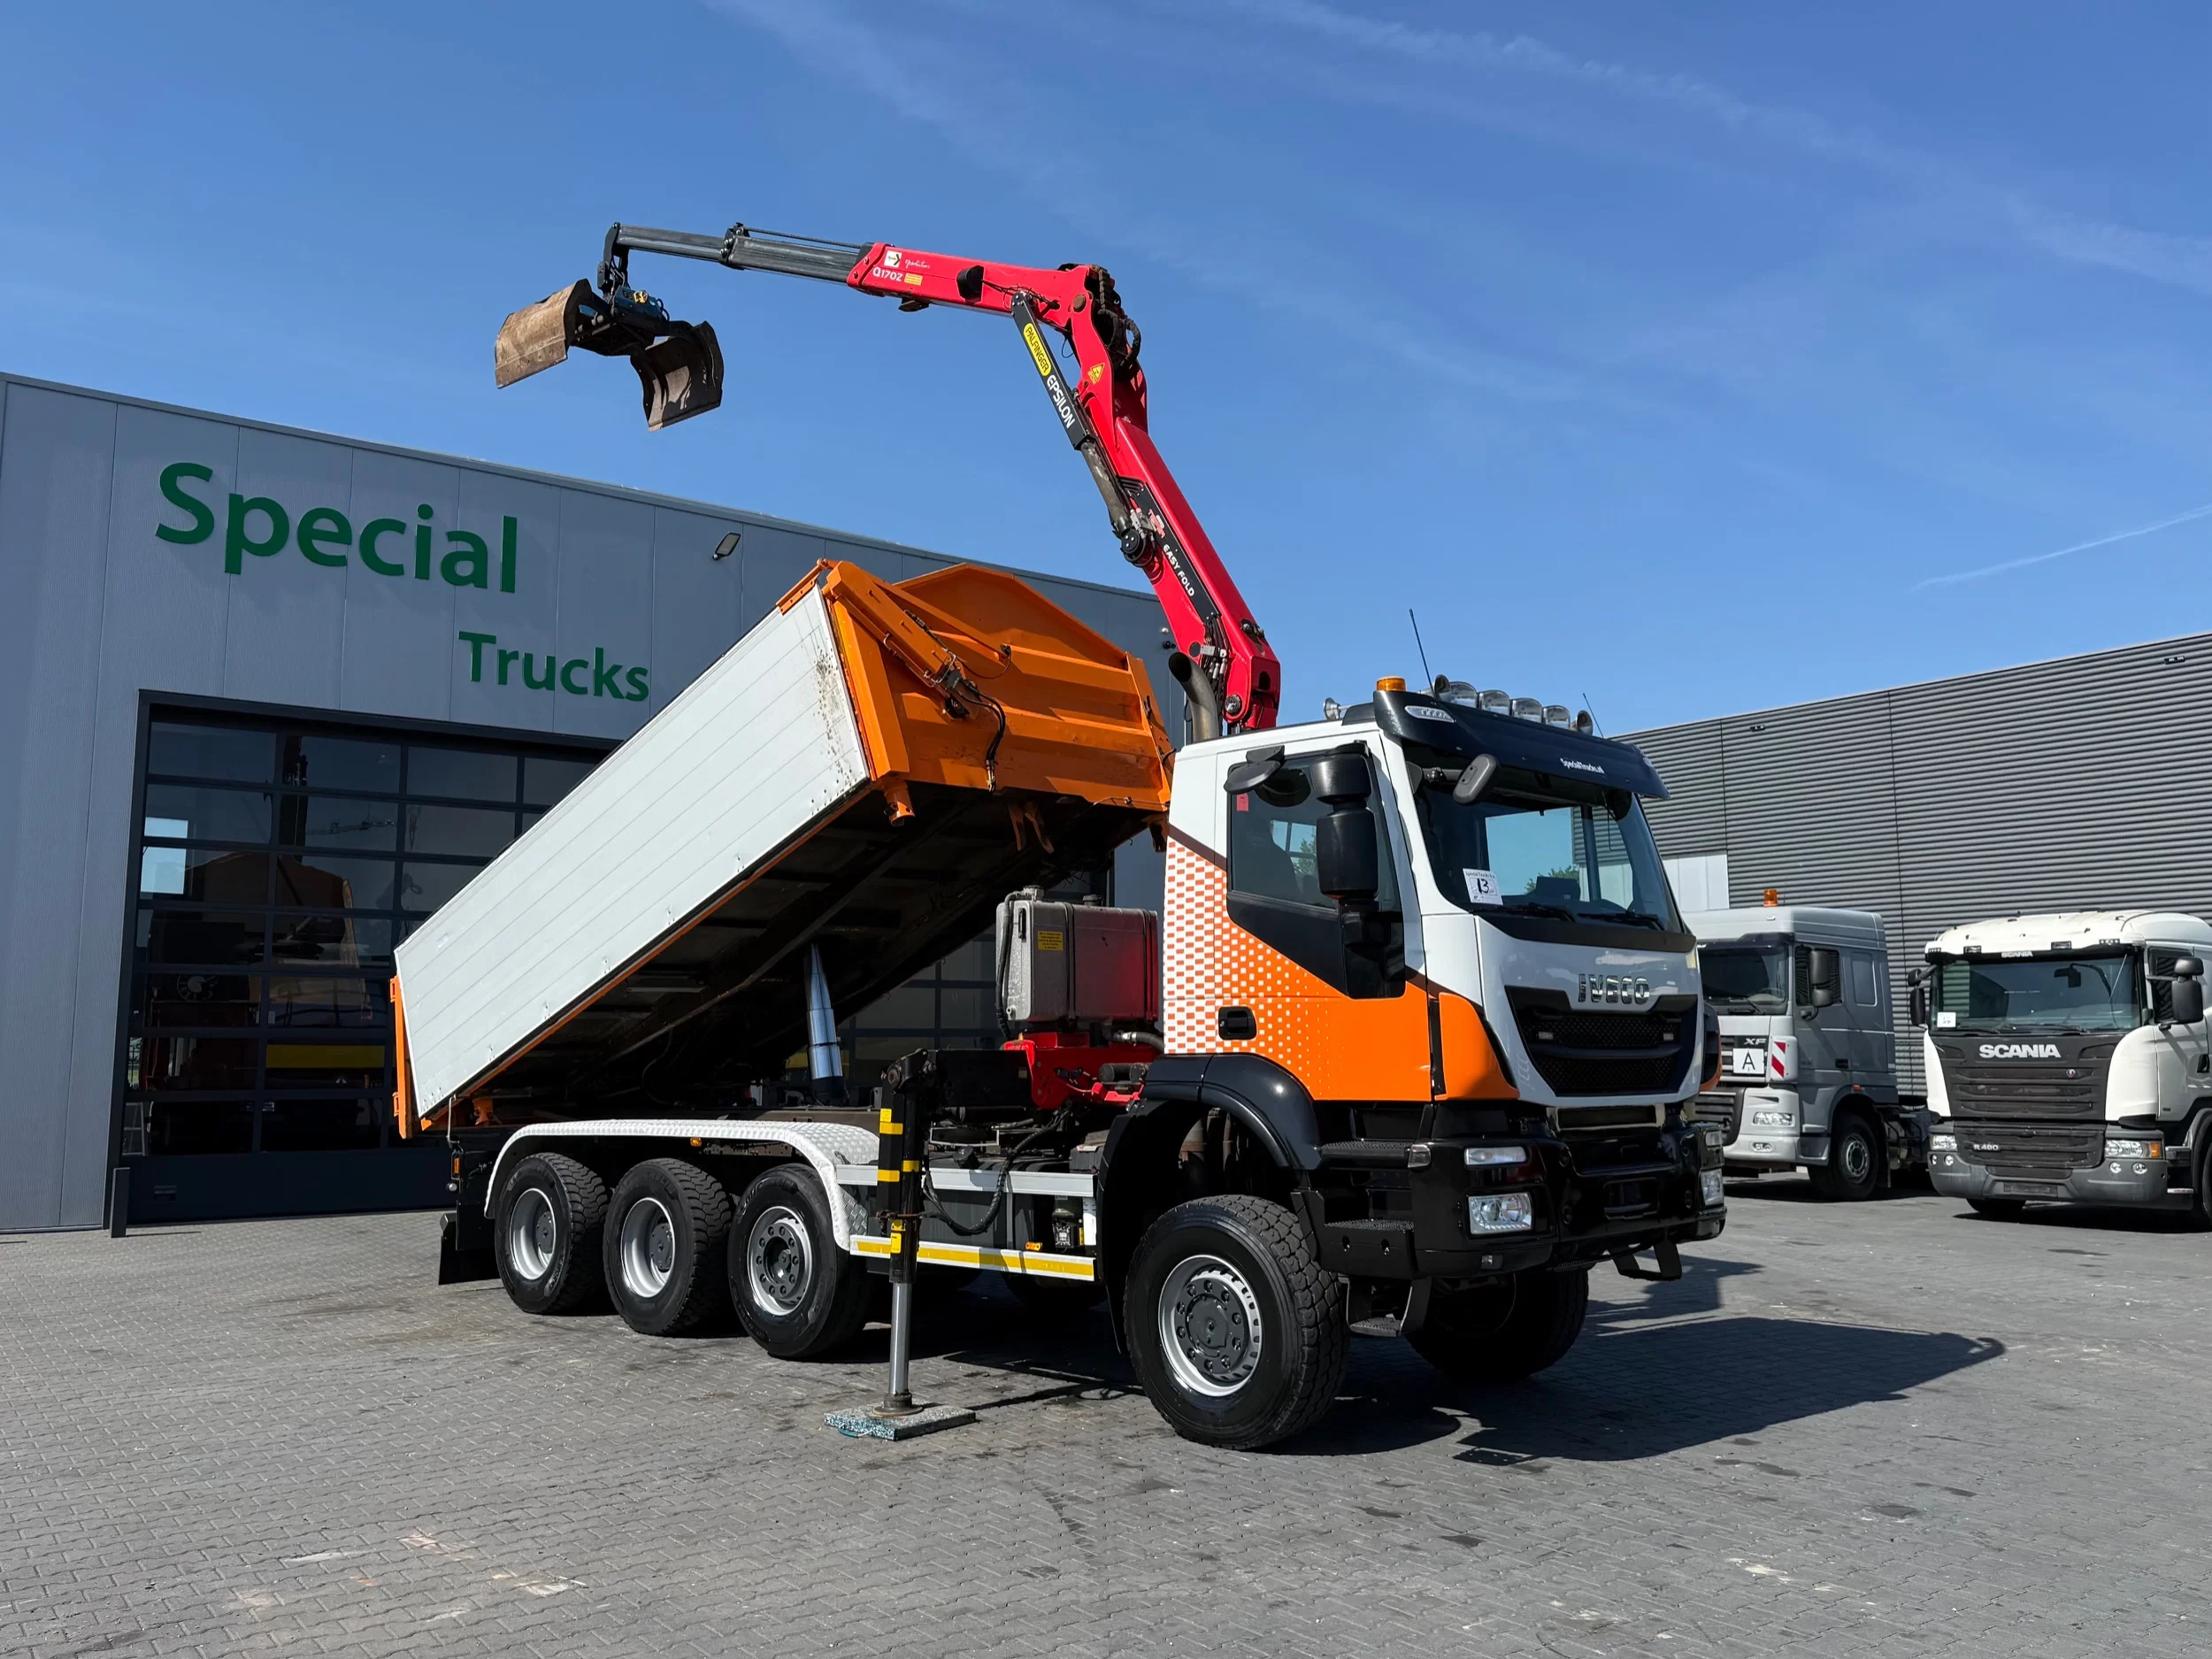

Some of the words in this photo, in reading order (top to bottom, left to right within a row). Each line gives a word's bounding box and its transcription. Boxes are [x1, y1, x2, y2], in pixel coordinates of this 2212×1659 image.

[872, 267, 902, 281] Q170Z
[1025, 326, 1049, 373] PALFINGER
[1047, 374, 1075, 428] EPSILON
[156, 462, 518, 593] Special
[1164, 544, 1180, 570] EASY
[1178, 571, 1195, 596] FOLD
[457, 631, 649, 703] Trucks
[1578, 973, 1650, 1005] IVECO
[1742, 1049, 1755, 1070] A
[1979, 1044, 2061, 1058] SCANIA
